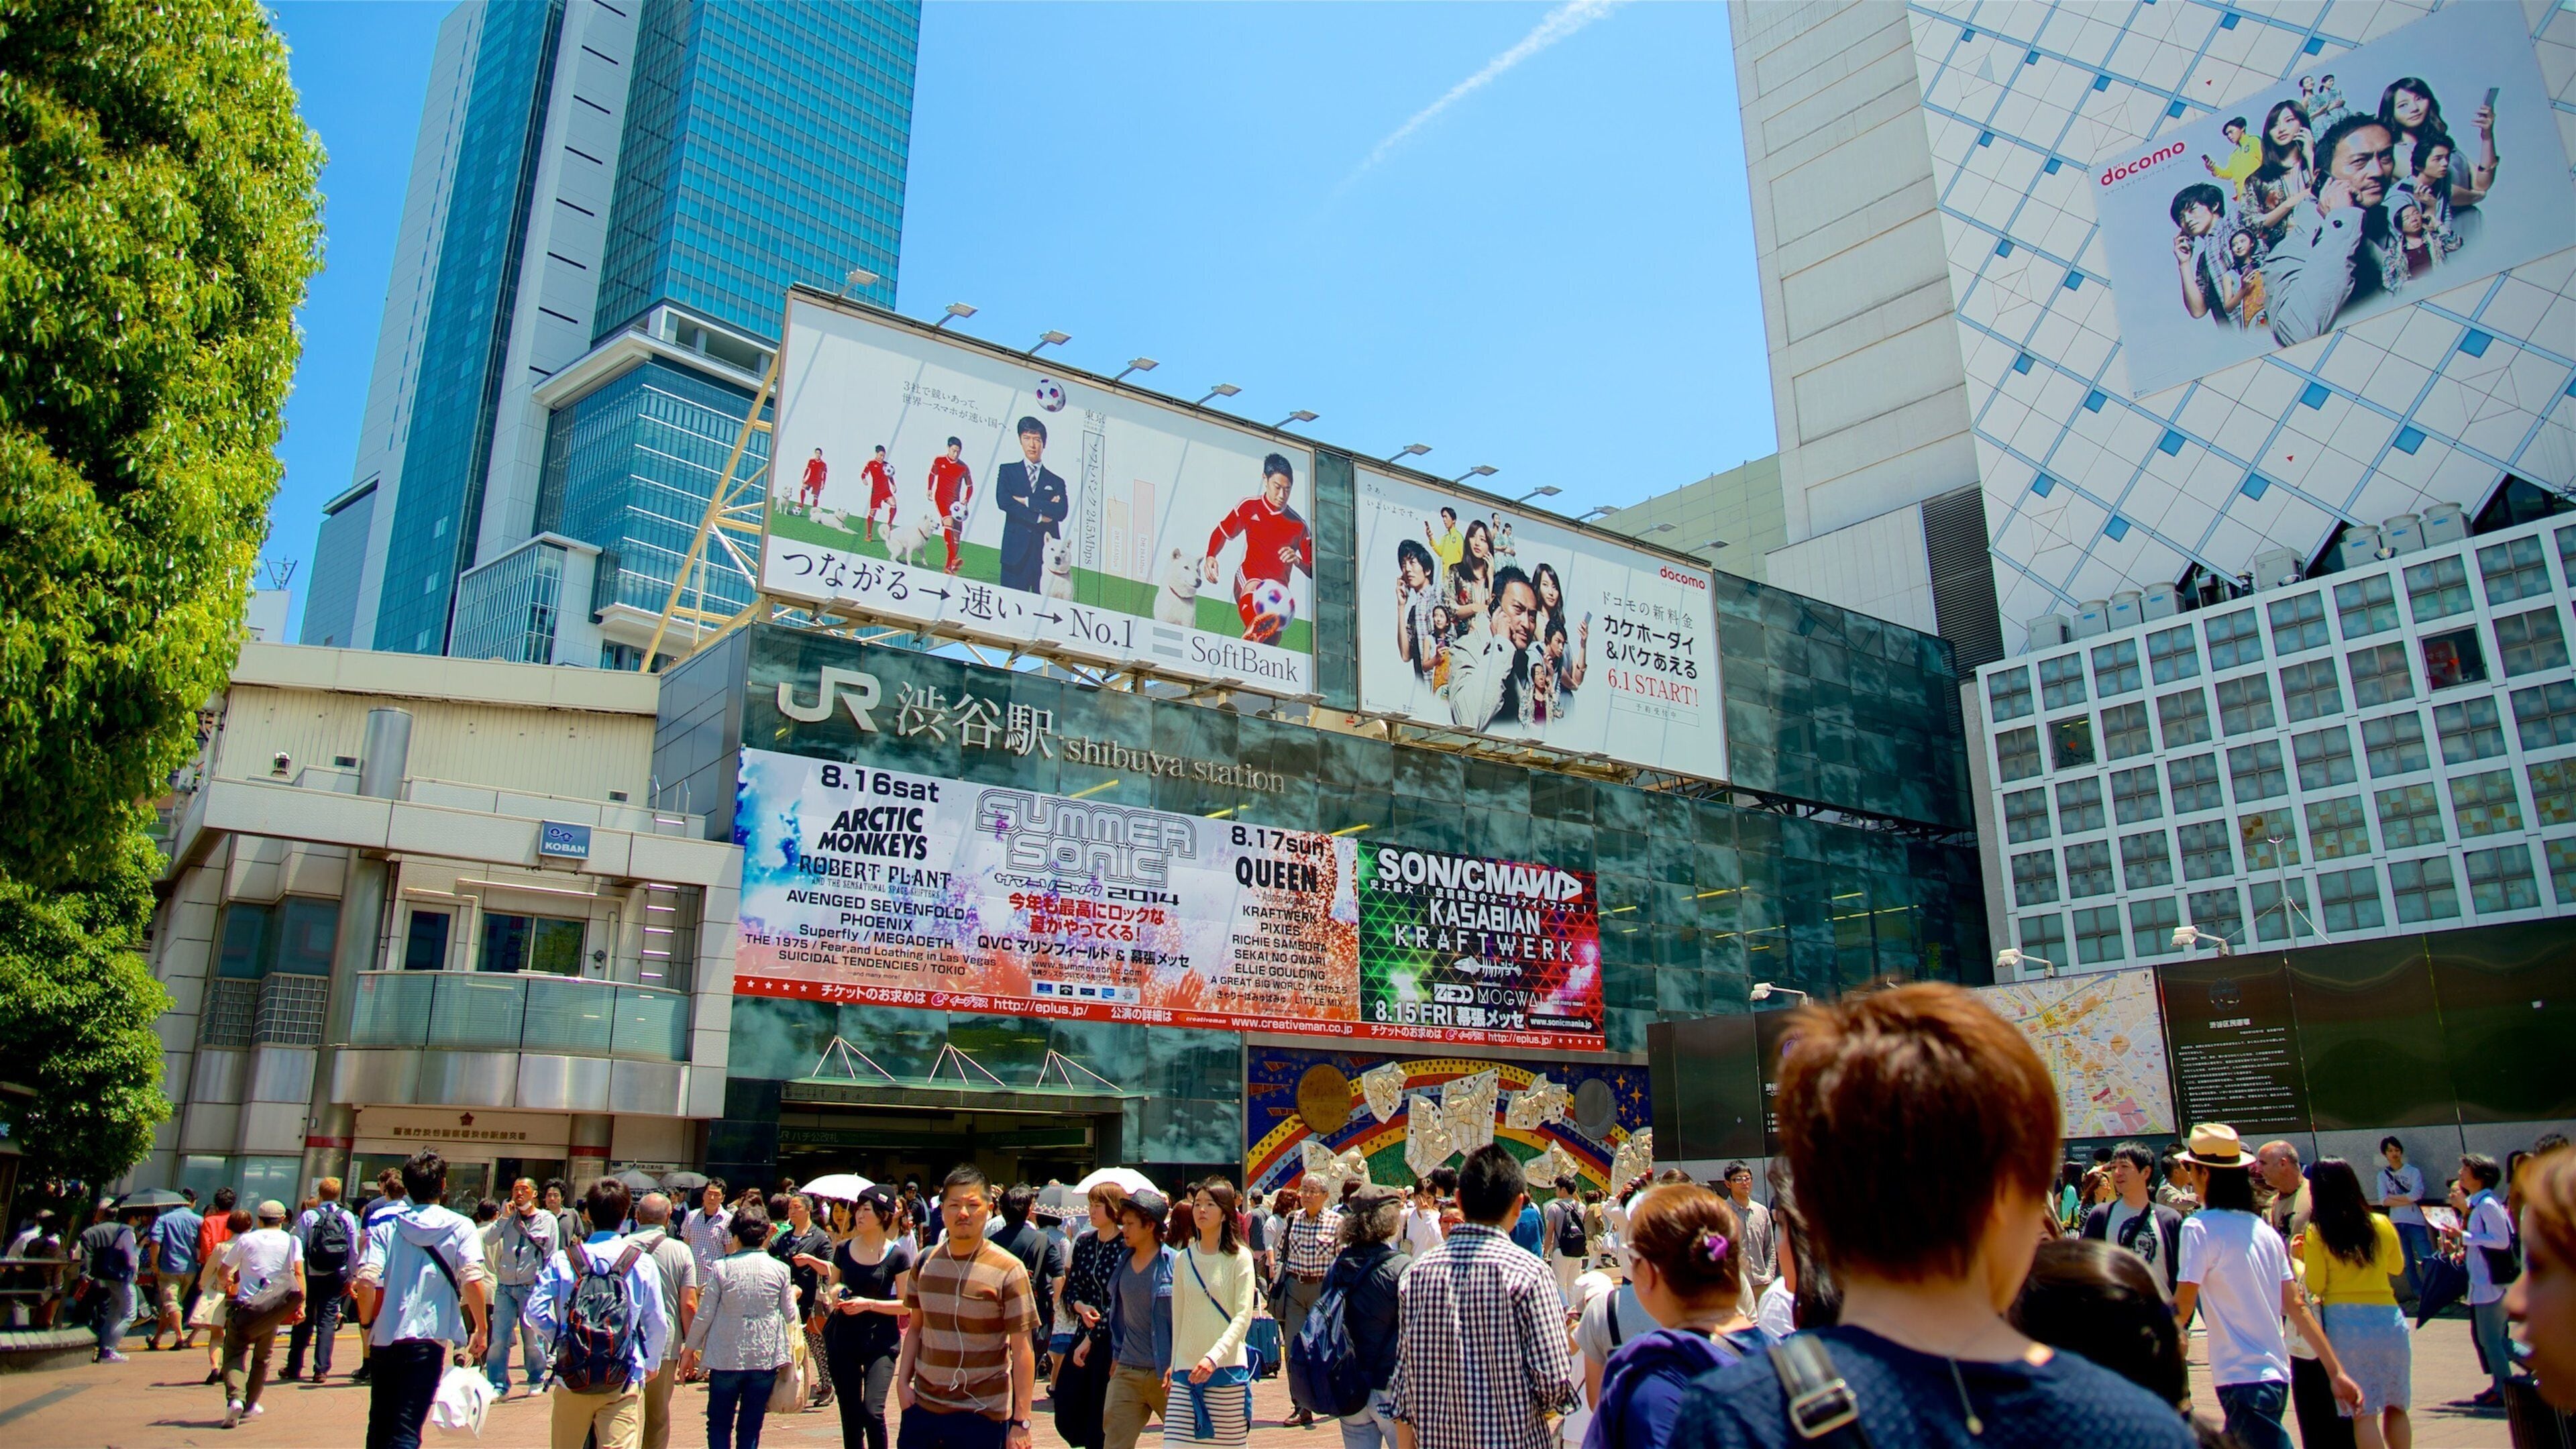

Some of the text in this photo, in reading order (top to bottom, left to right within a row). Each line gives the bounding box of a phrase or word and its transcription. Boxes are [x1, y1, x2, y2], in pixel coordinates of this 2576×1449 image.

[2101, 142, 2185, 186] docomo
[1084, 509, 1097, 565] 24.5Mbps
[1660, 566, 1705, 590] docomo
[783, 553, 1299, 682] つながる 速い No.1 SoftBank
[1603, 590, 1693, 629] ドコモの新料金
[1604, 614, 1694, 655] カケホーダイ
[1608, 668, 1699, 707] 6.1 START!
[777, 665, 1054, 759] JR 渋谷駅
[1065, 736, 1285, 793] shibuya station
[821, 764, 939, 803] 8.16sat
[830, 807, 924, 833] ARCTIC
[976, 789, 1196, 859] SUMMER
[545, 842, 586, 853] KOBAN
[817, 832, 928, 861] MONKEYS
[1232, 825, 1324, 857] 8.17sun
[798, 855, 952, 890] ROBERT PLANT
[1006, 832, 1167, 888] SONIC
[1236, 856, 1317, 893] QUEEN
[787, 890, 965, 920] AVENGED SEVENFOLD
[995, 873, 1179, 906] サマーソニック 2014
[841, 912, 913, 932] PHOENIX
[1009, 892, 1165, 925] 今年も最高にロックな
[1243, 905, 1318, 924] KRAFTWERK
[1430, 898, 1540, 936] KASABIAN
[799, 924, 859, 942] Superfly
[874, 931, 954, 949] MEGADETH
[1232, 934, 1327, 953] RICHIE SAMBORA
[1260, 922, 1301, 936] PIXIES
[1395, 924, 1573, 962] KRAFTWERK
[745, 934, 771, 945] THE
[776, 936, 808, 948] 1975
[820, 941, 871, 956] Fear,and
[874, 945, 923, 961] Loathing
[926, 951, 936, 960] in
[940, 950, 959, 963] Las
[963, 953, 996, 966] Vegas
[779, 951, 838, 965] SUICIDAL
[842, 956, 918, 971] TENDENCIES
[930, 964, 965, 975] TOKIO
[977, 935, 1189, 968] QVC マリンフィールド & 幕張メッセ
[1234, 949, 1326, 966] SEKAI NO OWARI
[1031, 959, 1142, 977] www.summersonic.com
[1235, 963, 1326, 980] ELLIE GOULDING
[1211, 975, 1217, 984] A
[1220, 976, 1251, 987] GREAT
[1255, 980, 1270, 988] BIG
[1273, 981, 1305, 991] WORLD
[1313, 984, 1348, 994] 木村カエラ
[1216, 989, 1287, 1004] きゃりーぱみゅぱみゅ
[1295, 997, 1325, 1006] LITTLE
[1327, 998, 1343, 1007] MIX
[1477, 987, 1544, 1008] MOGWAI
[822, 985, 926, 1004] チケットのお求めは
[994, 998, 1089, 1017] http://eplus.jp/
[1111, 1006, 1172, 1022] 公演の詳細は
[1185, 1015, 1226, 1024] creativeman
[1231, 1017, 1352, 1034] www.creativeman.co.jp
[1375, 1000, 1525, 1029] 8.15 FRI 幕張メッセ
[1529, 1016, 1593, 1030] www.sonicmania.jp
[1371, 1025, 1442, 1040] チケットのお求めは
[1488, 1031, 1553, 1045] http://eplus.jp/
